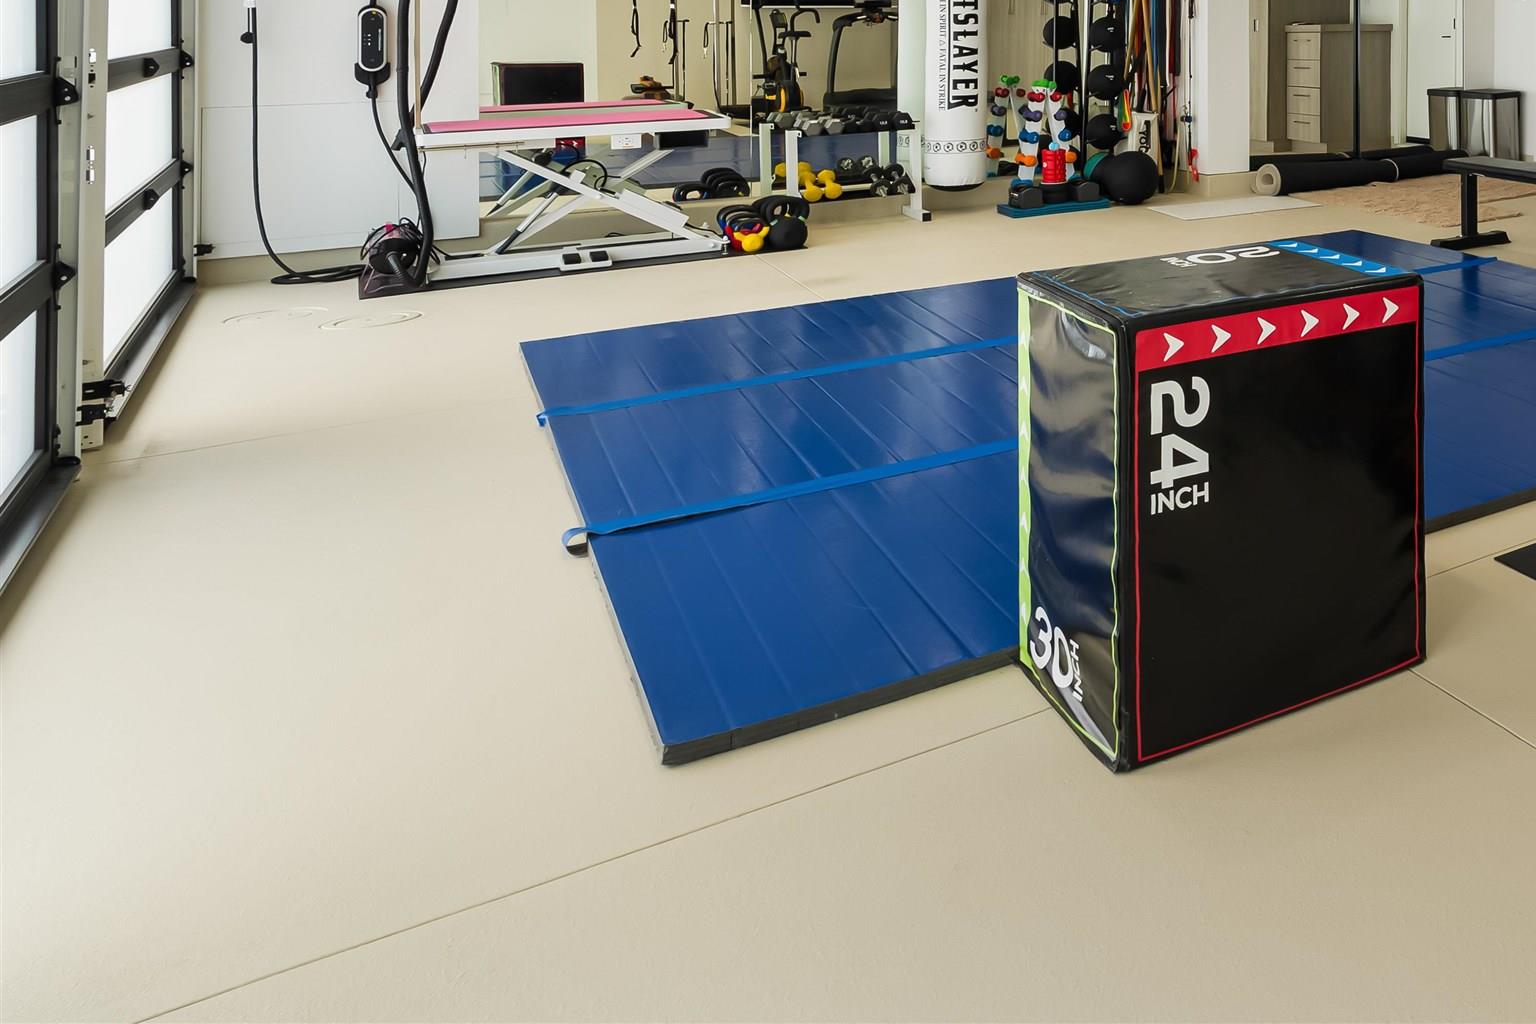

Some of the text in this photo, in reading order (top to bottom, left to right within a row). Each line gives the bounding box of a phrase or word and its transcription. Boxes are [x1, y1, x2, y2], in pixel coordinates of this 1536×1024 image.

[939, 4, 946, 14] IN
[939, 74, 946, 84] IN
[938, 85, 946, 111] STRIKE
[1186, 246, 1280, 264] 20
[1150, 376, 1210, 490] 24
[1150, 481, 1209, 516] INCH
[1030, 606, 1073, 688] 30
[1069, 638, 1083, 702] INCH
